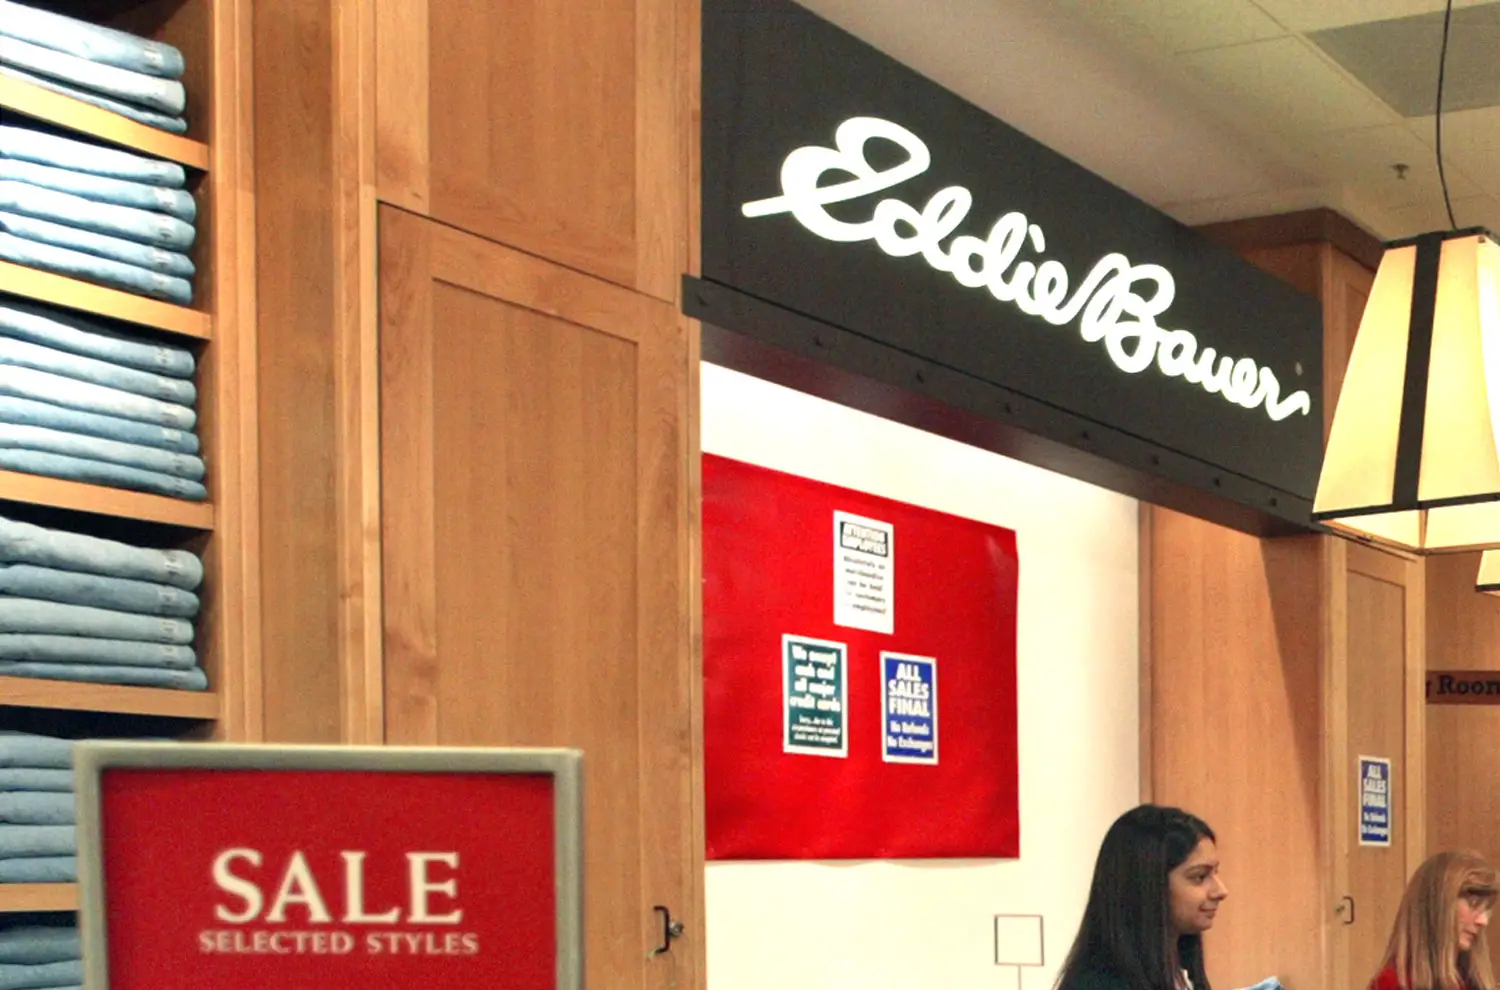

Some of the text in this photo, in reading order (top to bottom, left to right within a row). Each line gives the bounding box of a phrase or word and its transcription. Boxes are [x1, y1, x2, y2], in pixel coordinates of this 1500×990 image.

[742, 116, 1310, 421] Eddie Bauer
[896, 662, 922, 681] ALL
[888, 679, 929, 699] SALES
[889, 697, 930, 717] FINAL
[211, 847, 464, 926] SALE
[199, 930, 479, 955] SELECTED STYLES
